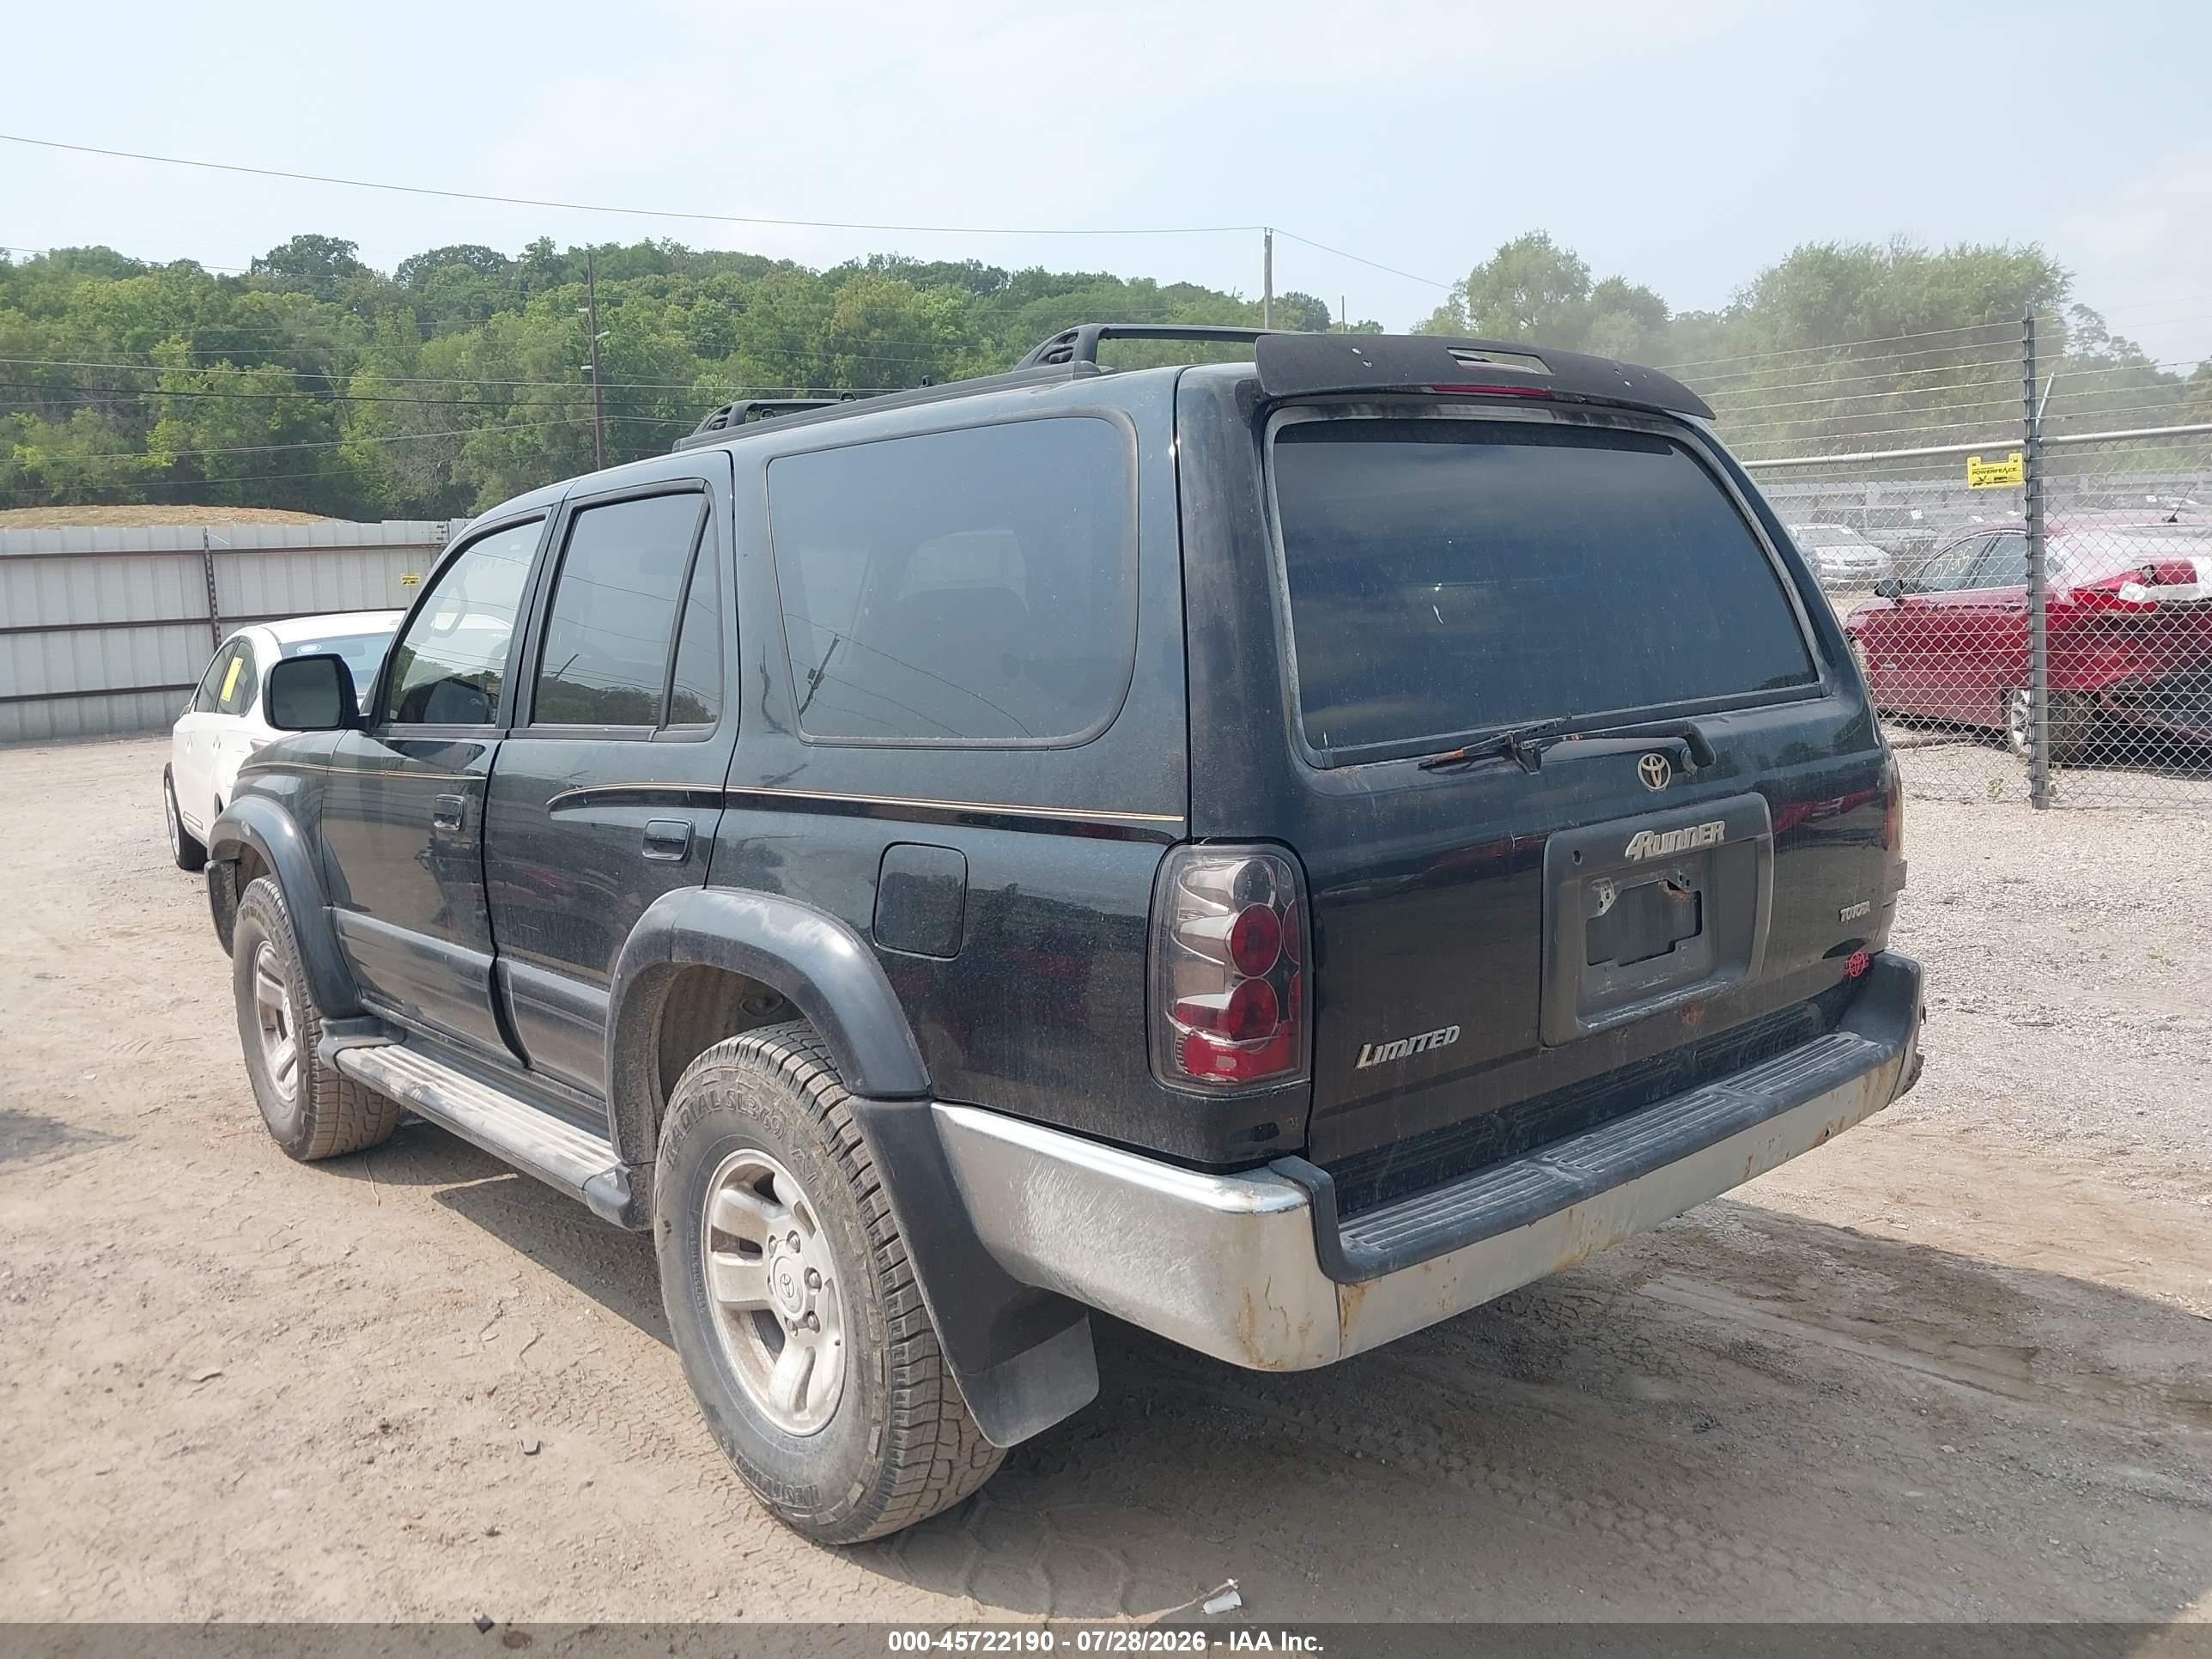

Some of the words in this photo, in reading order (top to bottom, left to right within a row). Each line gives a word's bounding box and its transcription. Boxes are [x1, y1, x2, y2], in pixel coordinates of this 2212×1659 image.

[1625, 820, 1725, 860] 4RUNNER
[1840, 901, 1870, 922] TOYOTA
[1355, 1024, 1461, 1068] LIMITED
